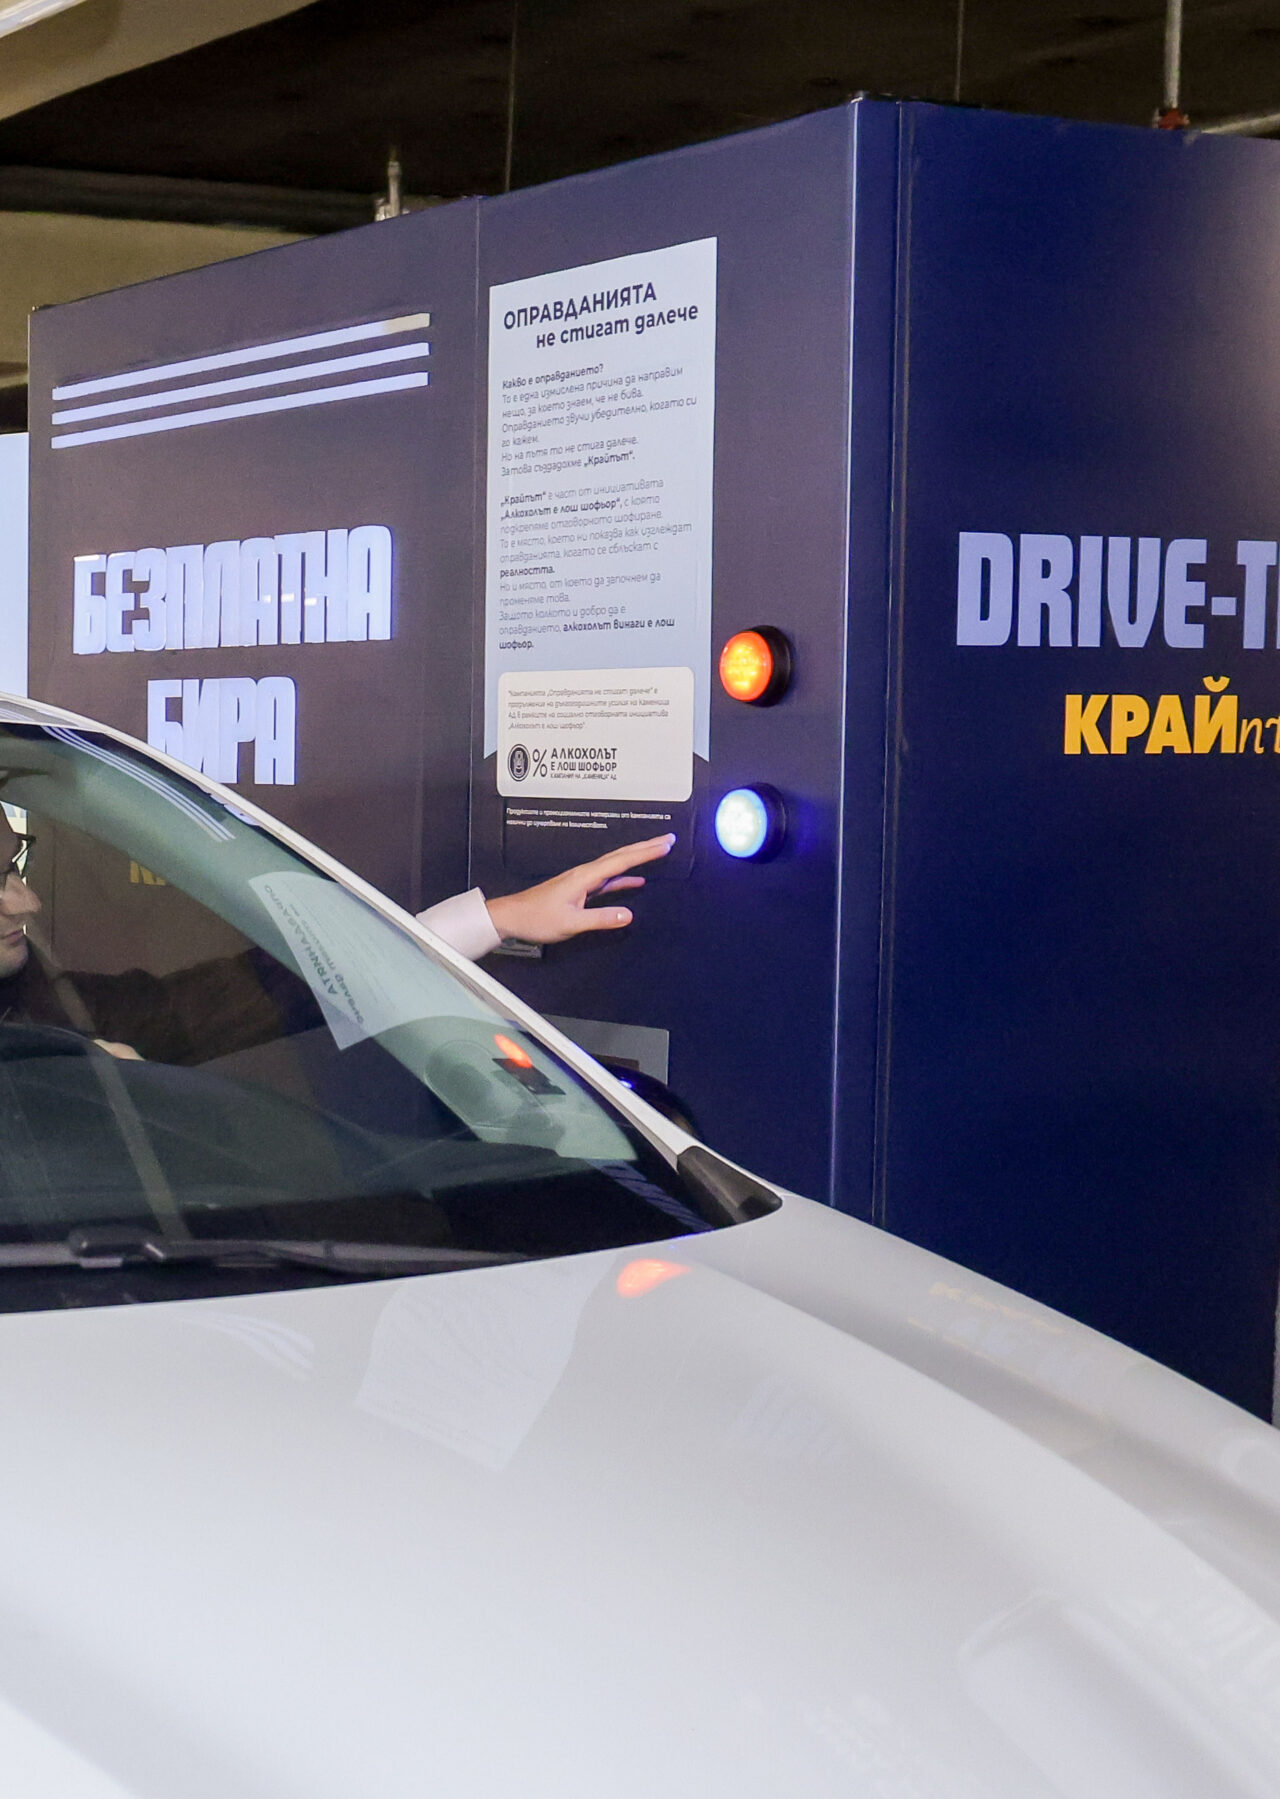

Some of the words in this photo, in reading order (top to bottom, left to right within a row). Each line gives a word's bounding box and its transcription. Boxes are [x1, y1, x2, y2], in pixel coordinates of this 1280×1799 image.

[504, 282, 657, 330] ОПРАВДАНИЯТА
[536, 334, 556, 348] не
[561, 317, 629, 343] стигат
[635, 305, 699, 334] далече
[502, 394, 511, 404] То
[513, 394, 518, 402] е
[520, 391, 539, 403] една
[541, 383, 584, 399] измислена
[586, 377, 623, 392] причина
[625, 375, 636, 386] да
[638, 367, 683, 382] направим
[503, 377, 526, 390] Какво
[529, 376, 533, 385] е
[536, 362, 604, 384] оправданието?
[502, 415, 564, 432] Оправданието
[566, 411, 590, 425] звучи
[650, 398, 684, 410] когато
[686, 396, 697, 405] си
[528, 405, 536, 416] за
[538, 401, 565, 413] което
[595, 395, 605, 404] че
[608, 393, 618, 402] не
[73, 525, 392, 654] БЕЗПЛАТНА
[956, 531, 1280, 650] DRIVE-T
[563, 621, 611, 632] алкохолът
[614, 619, 644, 629] винаги
[655, 618, 675, 627] лош
[147, 676, 296, 785] БИРА
[551, 748, 617, 760] АЛКОХОЛЪТ
[551, 762, 555, 771] Е
[557, 762, 577, 771] ЛОШ
[578, 762, 617, 771] ШОФЬОР
